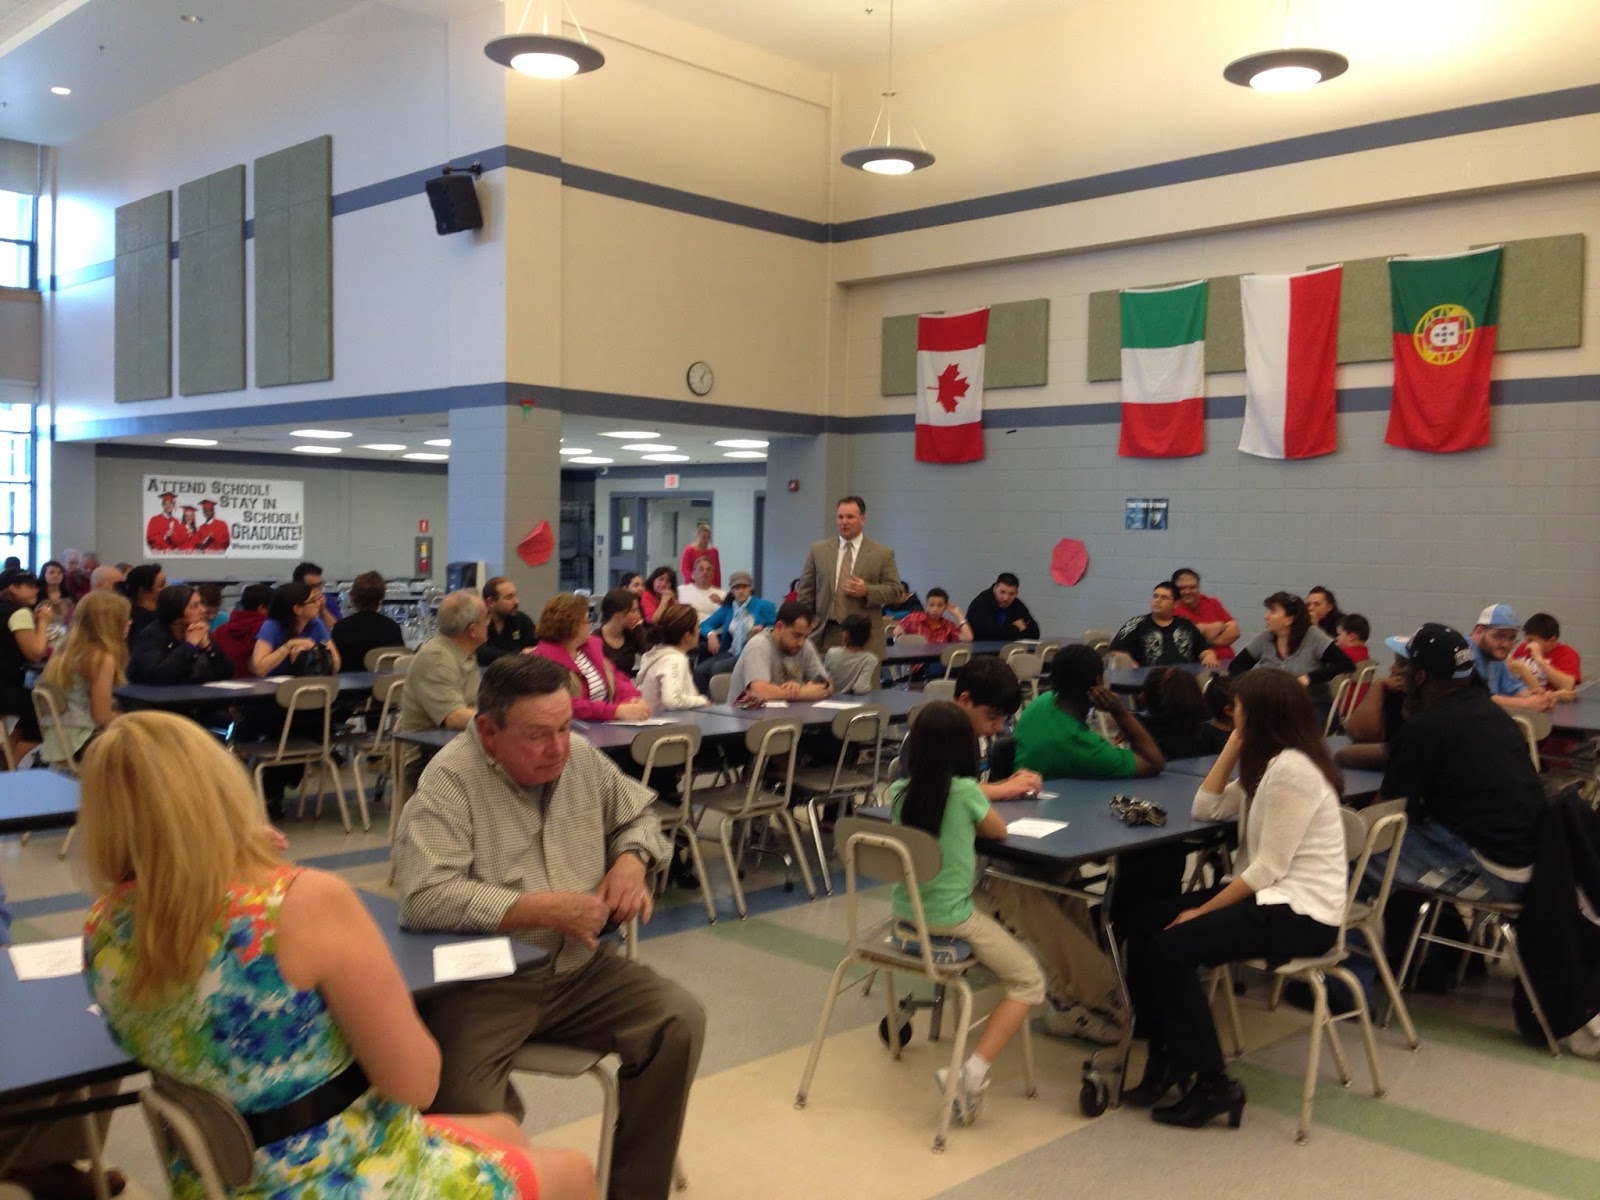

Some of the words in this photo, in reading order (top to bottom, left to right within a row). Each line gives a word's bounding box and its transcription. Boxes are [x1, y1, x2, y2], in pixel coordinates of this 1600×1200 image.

[147, 479, 206, 494] ATTEND
[211, 481, 270, 496] SCHOOL!
[219, 495, 258, 509] STAY
[262, 498, 277, 510] IN
[243, 510, 300, 524] SCHOOL!
[231, 523, 302, 541] GRADUATE!
